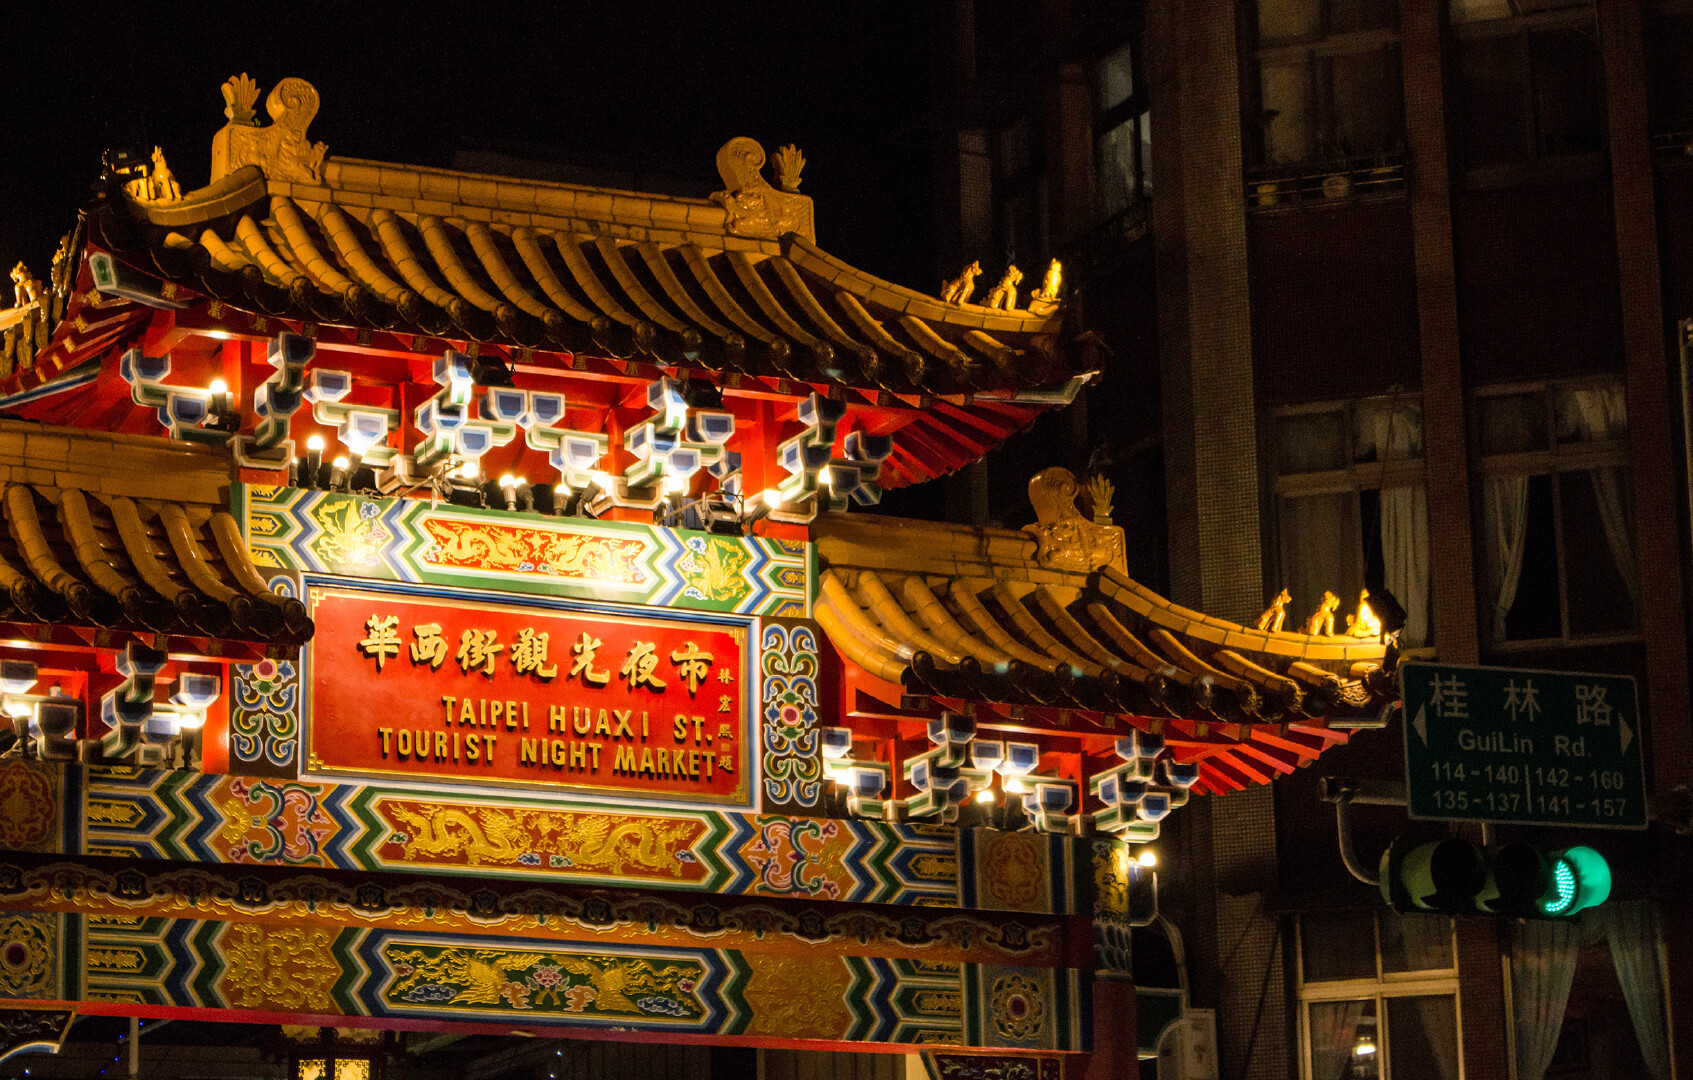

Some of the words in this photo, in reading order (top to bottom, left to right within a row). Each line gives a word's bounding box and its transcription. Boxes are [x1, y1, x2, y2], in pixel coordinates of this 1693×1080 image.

[359, 613, 714, 693] 華西街觀光夜市
[442, 696, 529, 728] TAIPEI
[550, 705, 649, 737] HUAXI
[674, 714, 713, 742] ST.
[1429, 672, 1614, 727] 桂林路
[379, 727, 497, 761] TOURIST
[521, 737, 601, 769] NIGHT
[615, 746, 715, 779] MARKET
[1458, 729, 1533, 754] GuiLin
[1555, 735, 1591, 757] Rd.
